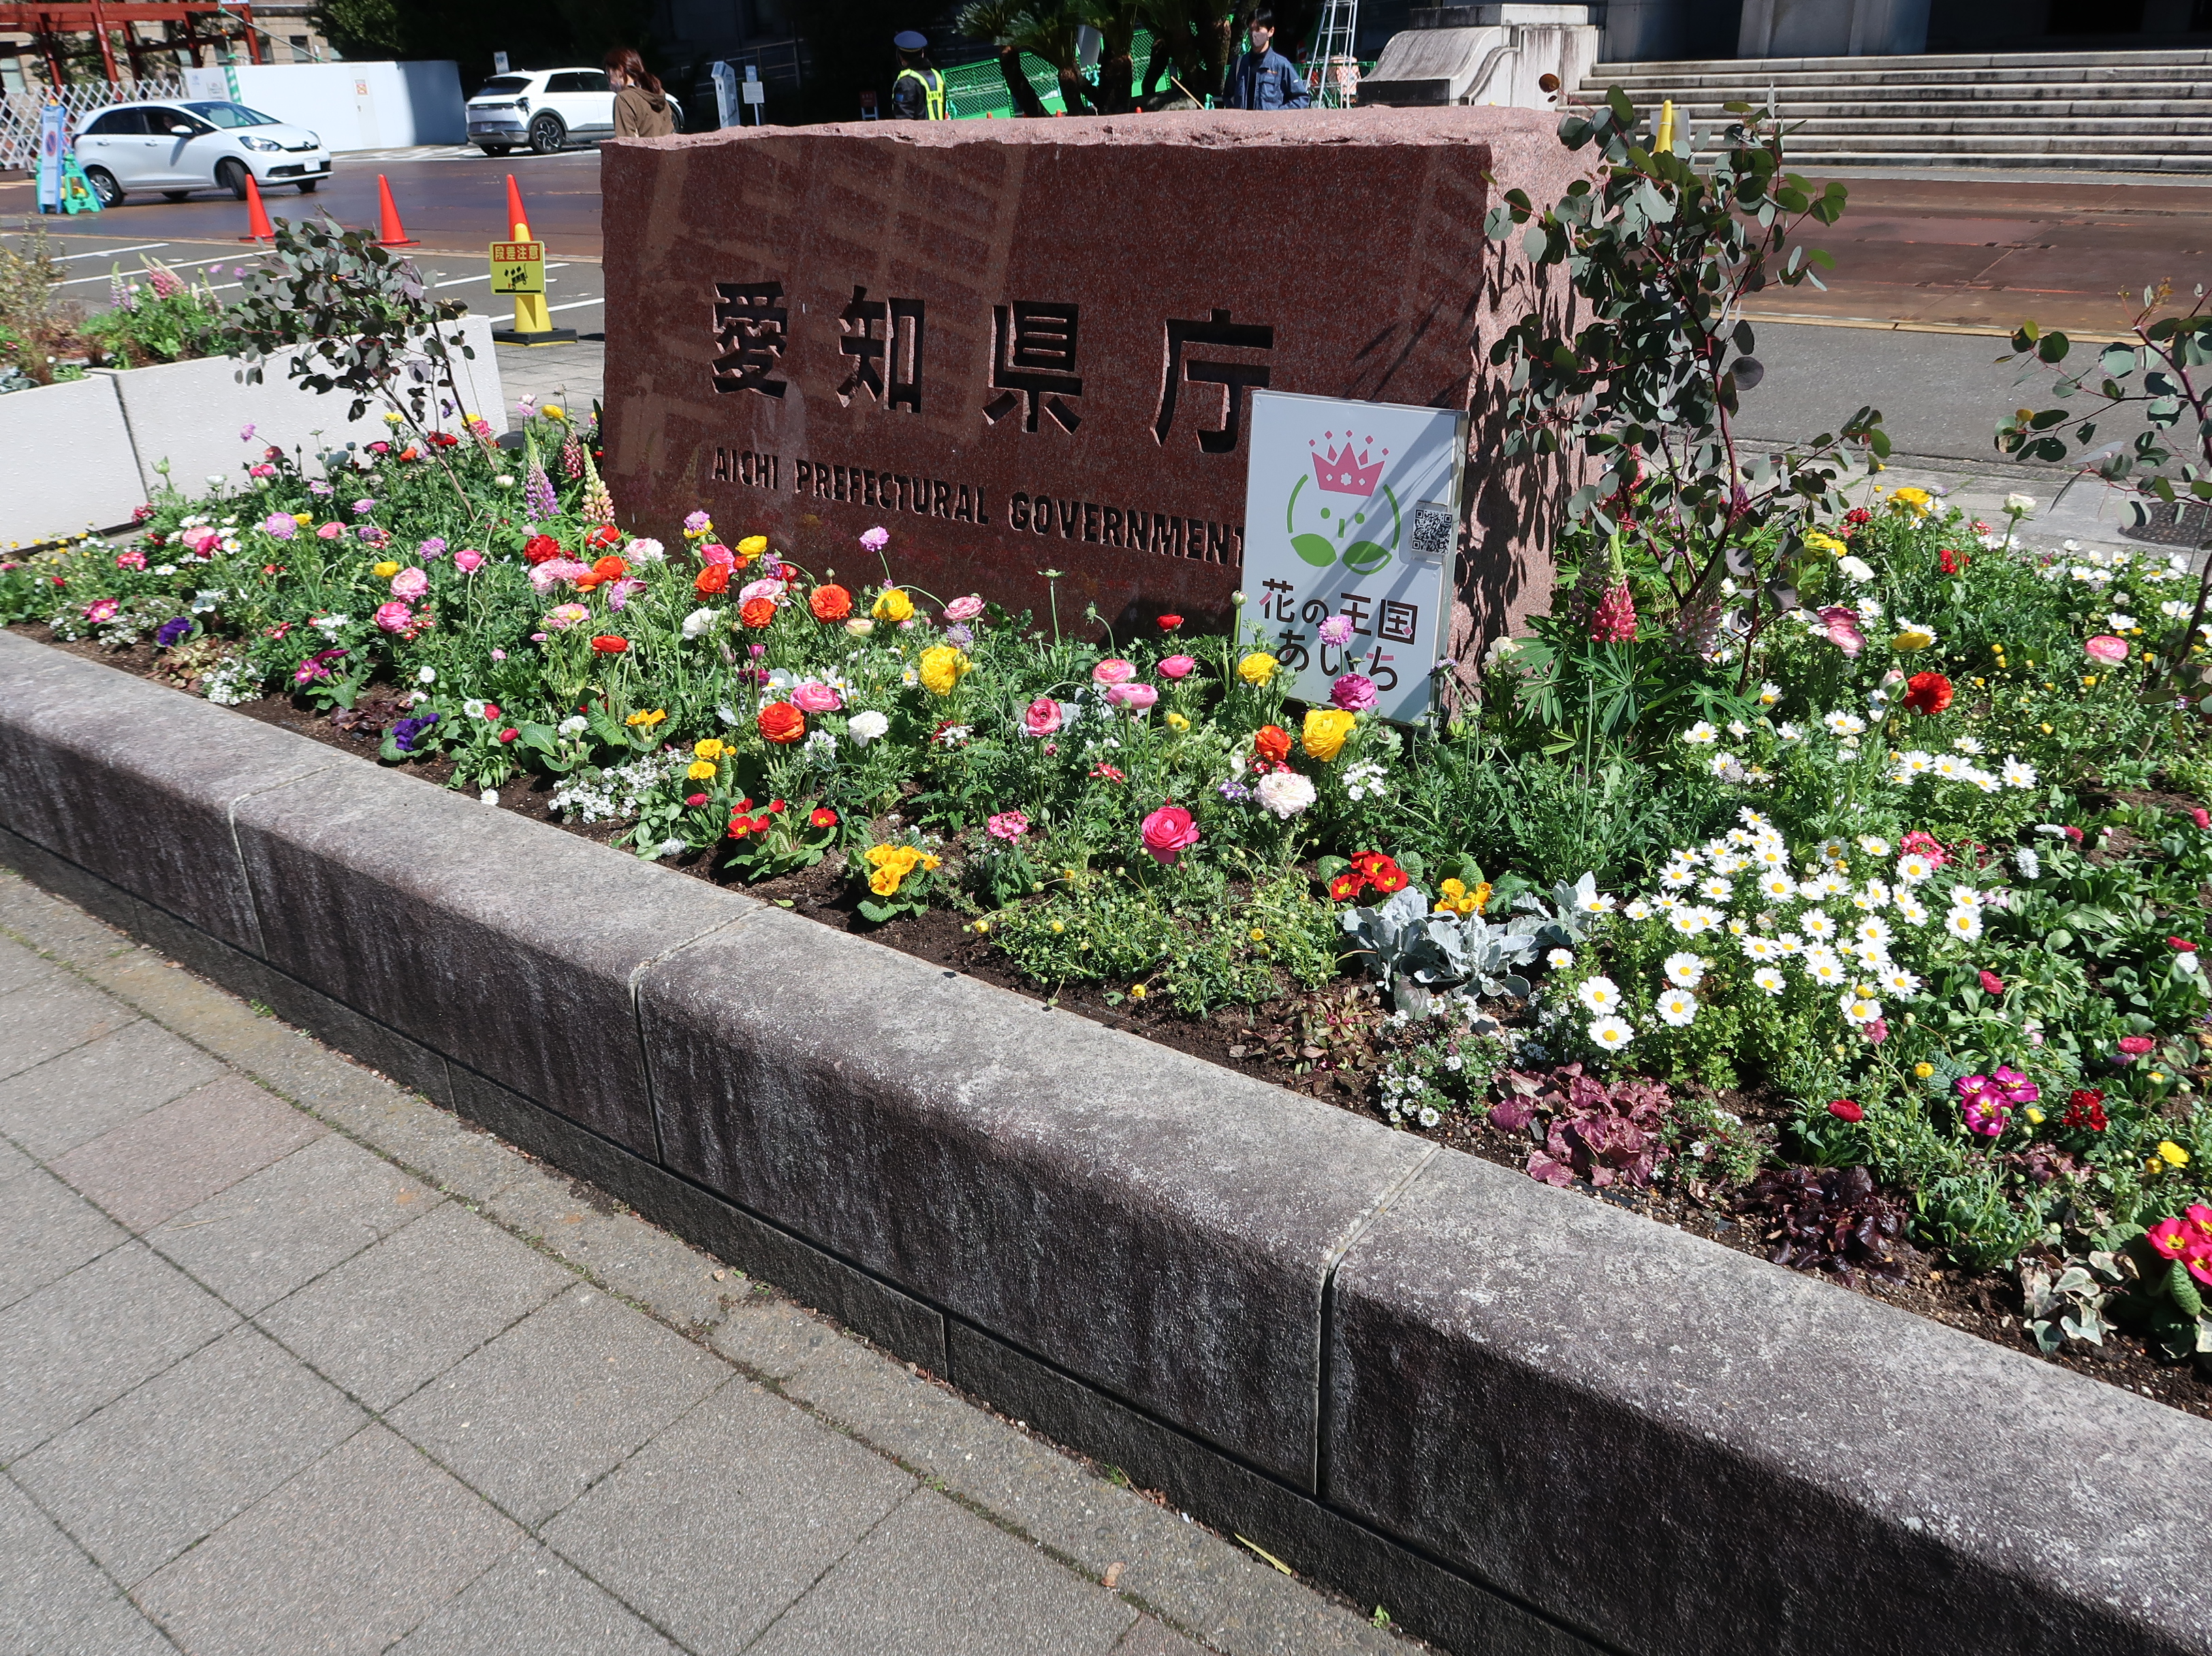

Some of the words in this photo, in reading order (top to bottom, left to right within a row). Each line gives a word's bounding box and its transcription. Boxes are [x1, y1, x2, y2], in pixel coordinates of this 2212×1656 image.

[494, 244, 539, 260] 段差注意
[712, 281, 1274, 453] 愛知県庁
[711, 446, 779, 490] AICHI
[794, 458, 989, 525] PREFECTURAL
[1259, 578, 1419, 646] 花の王国
[1275, 629, 1398, 692] あいち
